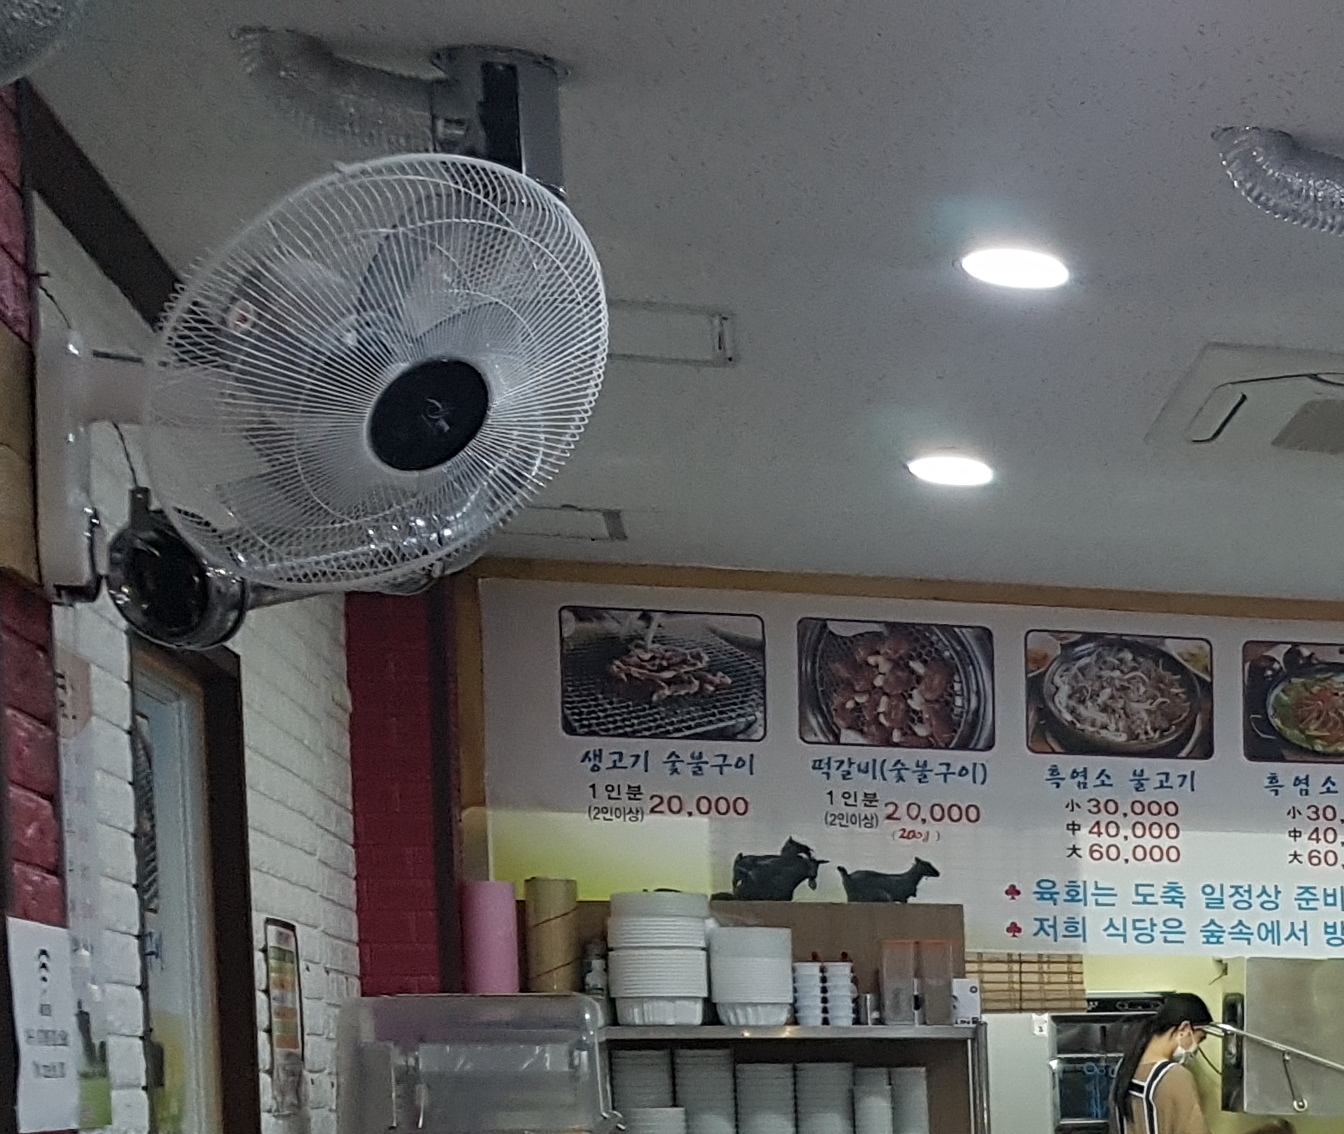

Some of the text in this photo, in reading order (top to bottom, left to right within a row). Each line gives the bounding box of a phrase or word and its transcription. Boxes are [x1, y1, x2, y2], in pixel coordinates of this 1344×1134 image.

[580, 748, 754, 776] 생고기 숯불구이
[1045, 764, 1195, 792] 흑염소 불고기
[1264, 772, 1339, 797] 흑염소
[588, 806, 645, 823] (2인이상)
[649, 795, 749, 817] 20,000
[884, 802, 981, 825] 20,000
[1065, 798, 1179, 818] 小 30,000
[1286, 806, 1302, 819] 小
[824, 812, 879, 829] (2인이상)
[1066, 820, 1180, 841] 中 40,000
[1288, 827, 1302, 842] 中
[1066, 843, 1181, 864] 大 60,000
[1288, 850, 1303, 864] 大
[1033, 879, 1118, 907] 육회는
[1132, 881, 1186, 909] 도축
[1201, 883, 1282, 911] 일정상
[1033, 916, 1087, 943] 저희
[1102, 917, 1186, 944] 식당은
[1200, 918, 1309, 946] 숲속에서
